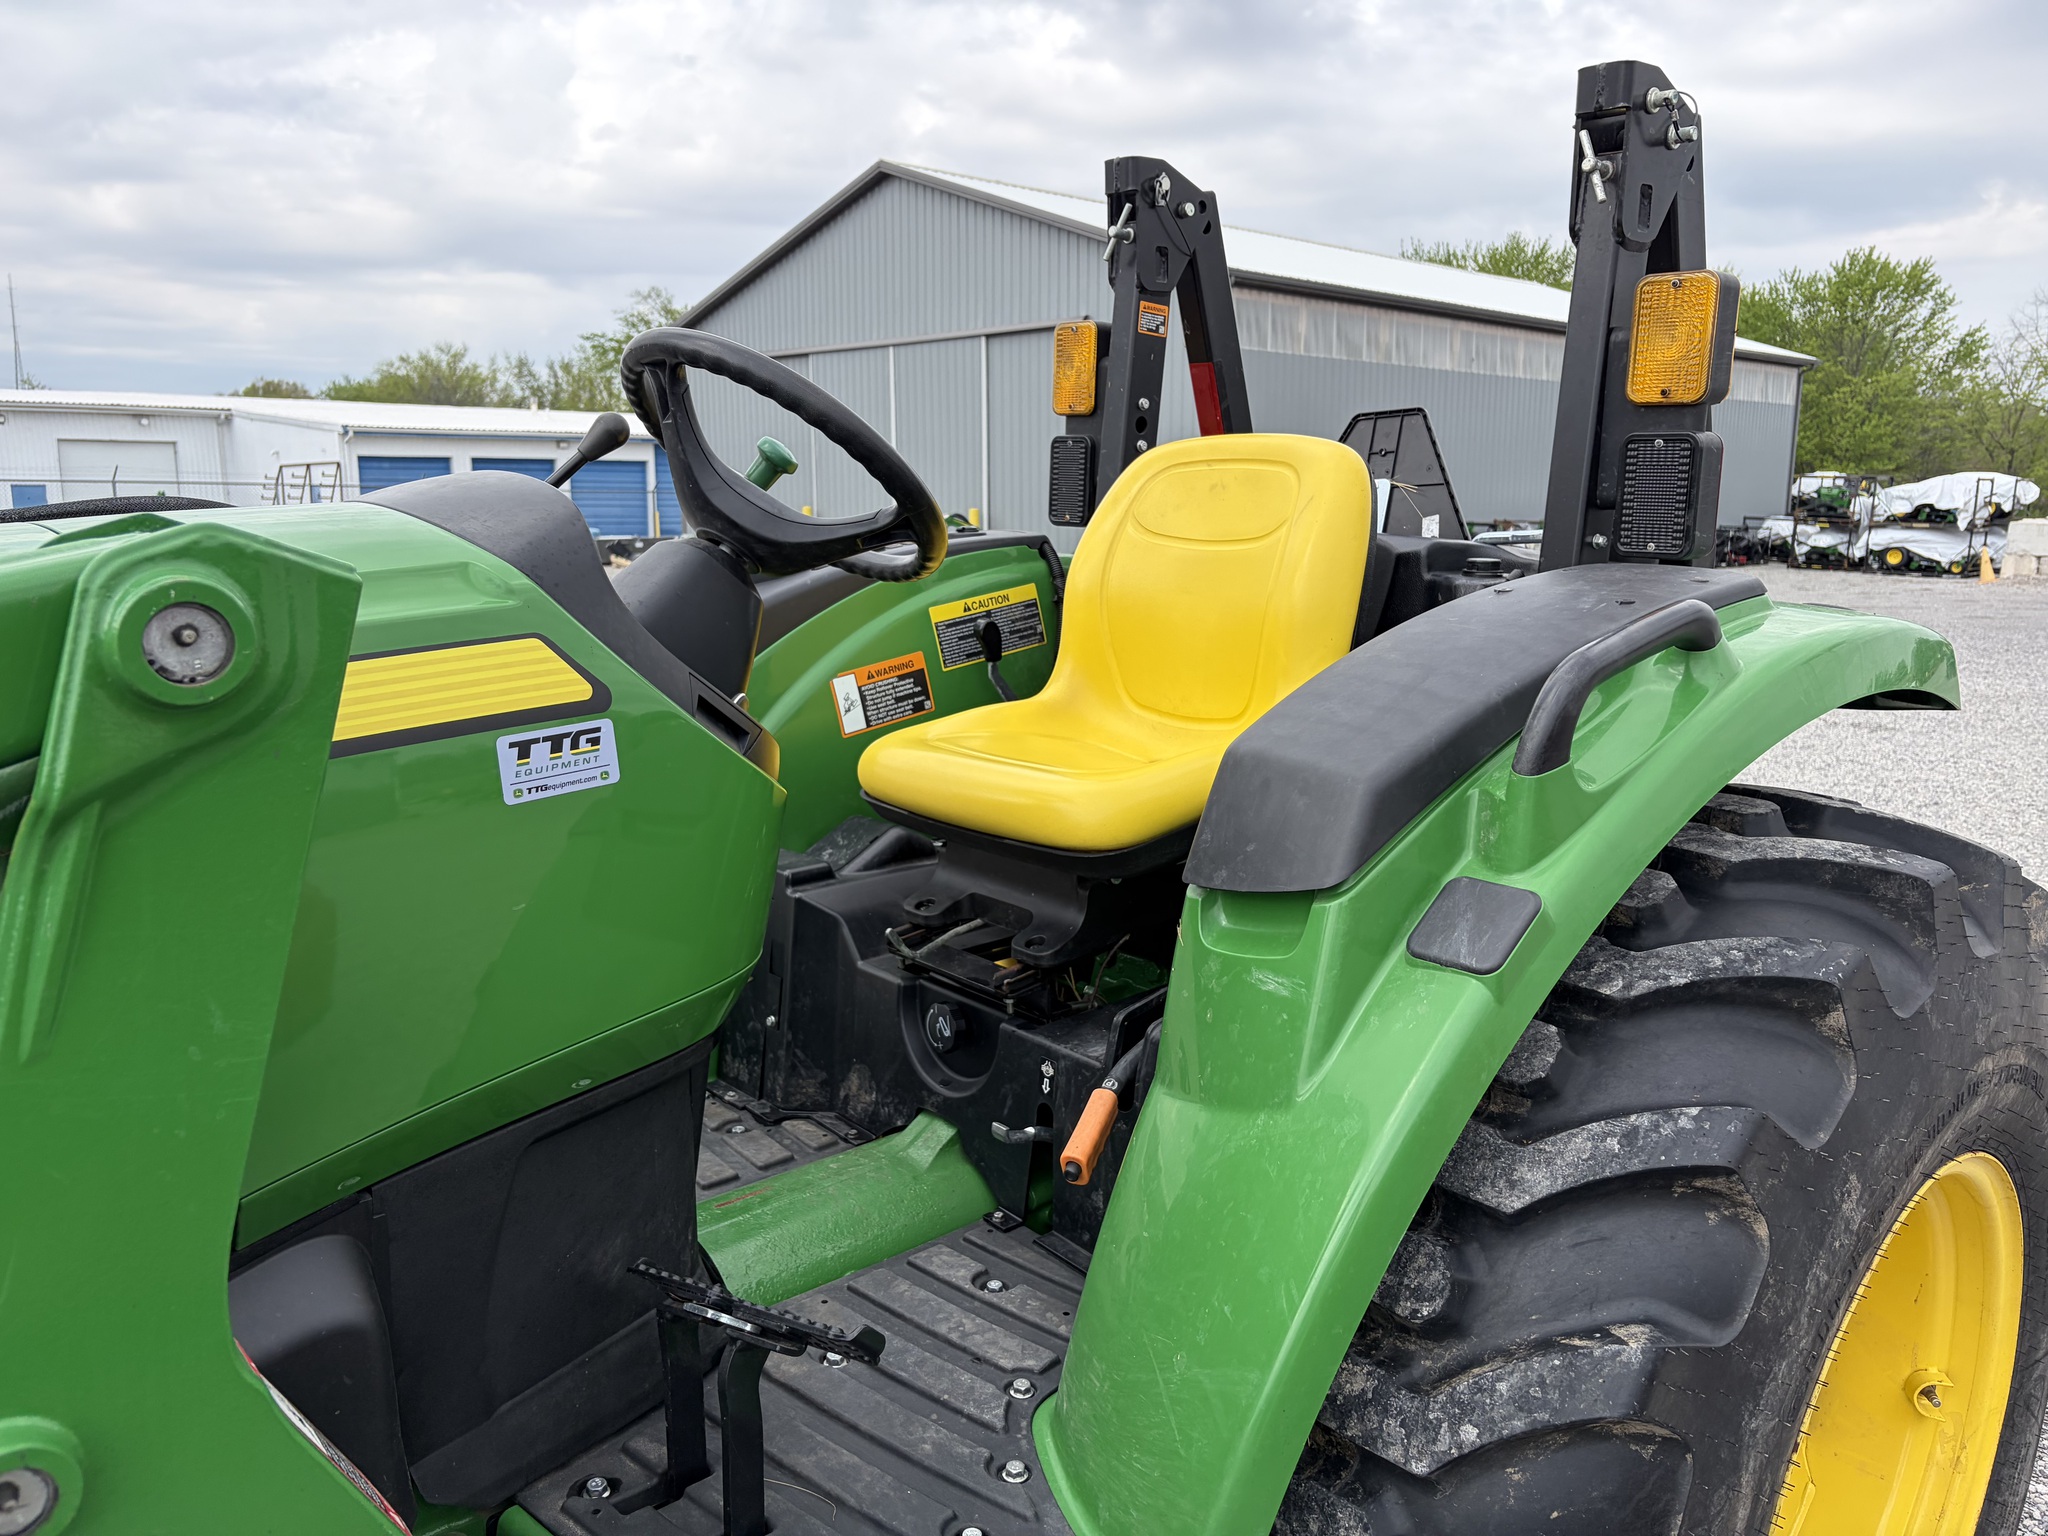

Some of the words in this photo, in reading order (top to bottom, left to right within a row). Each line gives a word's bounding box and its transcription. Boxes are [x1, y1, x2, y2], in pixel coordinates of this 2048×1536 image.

[971, 593, 1010, 611] CAUTION
[874, 660, 914, 677] WARNING
[508, 726, 602, 767] TTG
[515, 755, 600, 779] EQUIPMENT
[526, 775, 598, 795] TTGequipment.com
